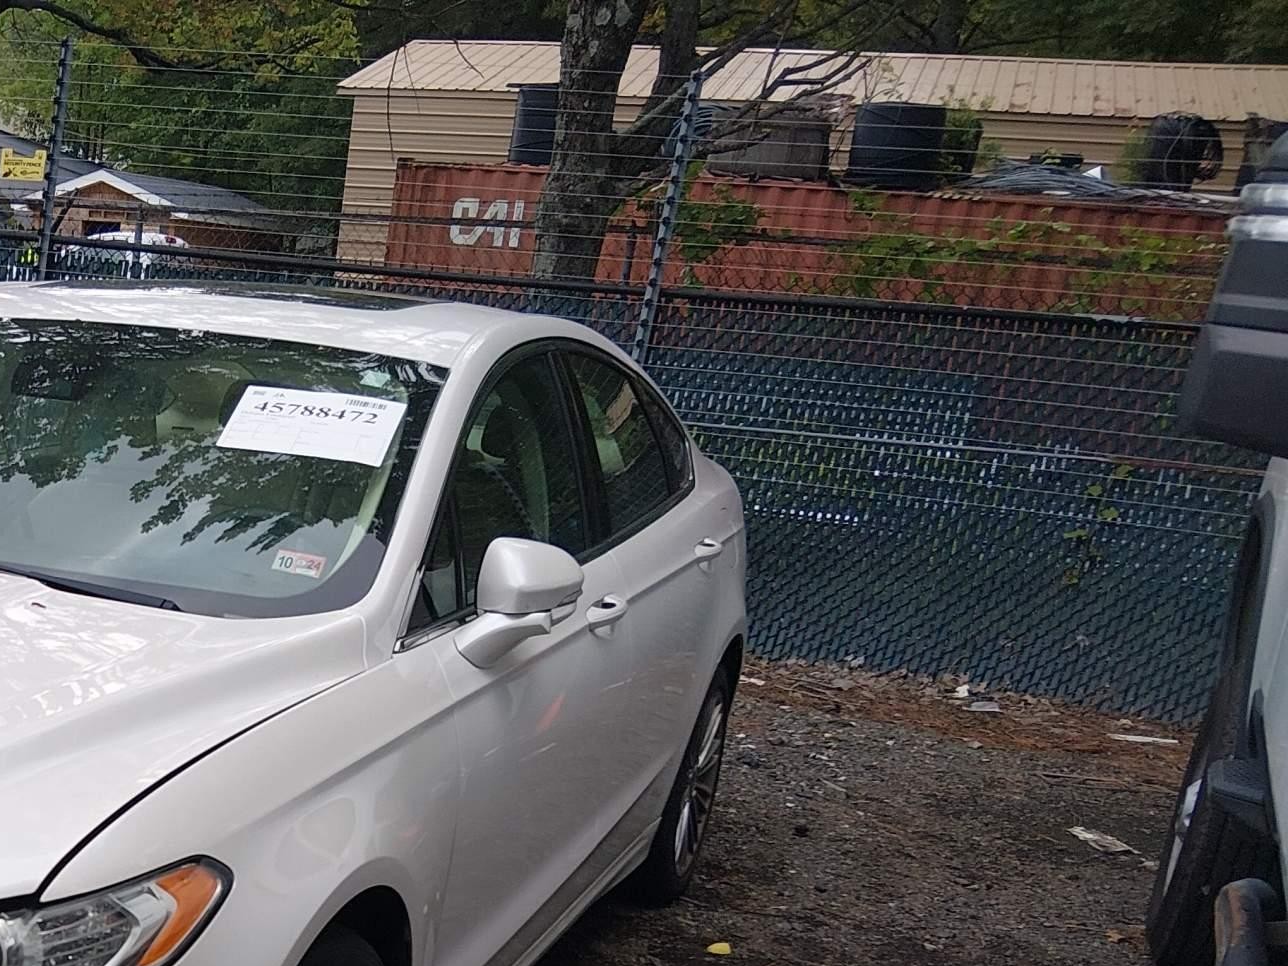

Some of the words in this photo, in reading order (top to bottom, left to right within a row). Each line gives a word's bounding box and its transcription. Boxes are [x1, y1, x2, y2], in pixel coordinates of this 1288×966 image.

[253, 401, 378, 425] 45788472
[278, 556, 294, 569] 10
[306, 560, 321, 572] 24
